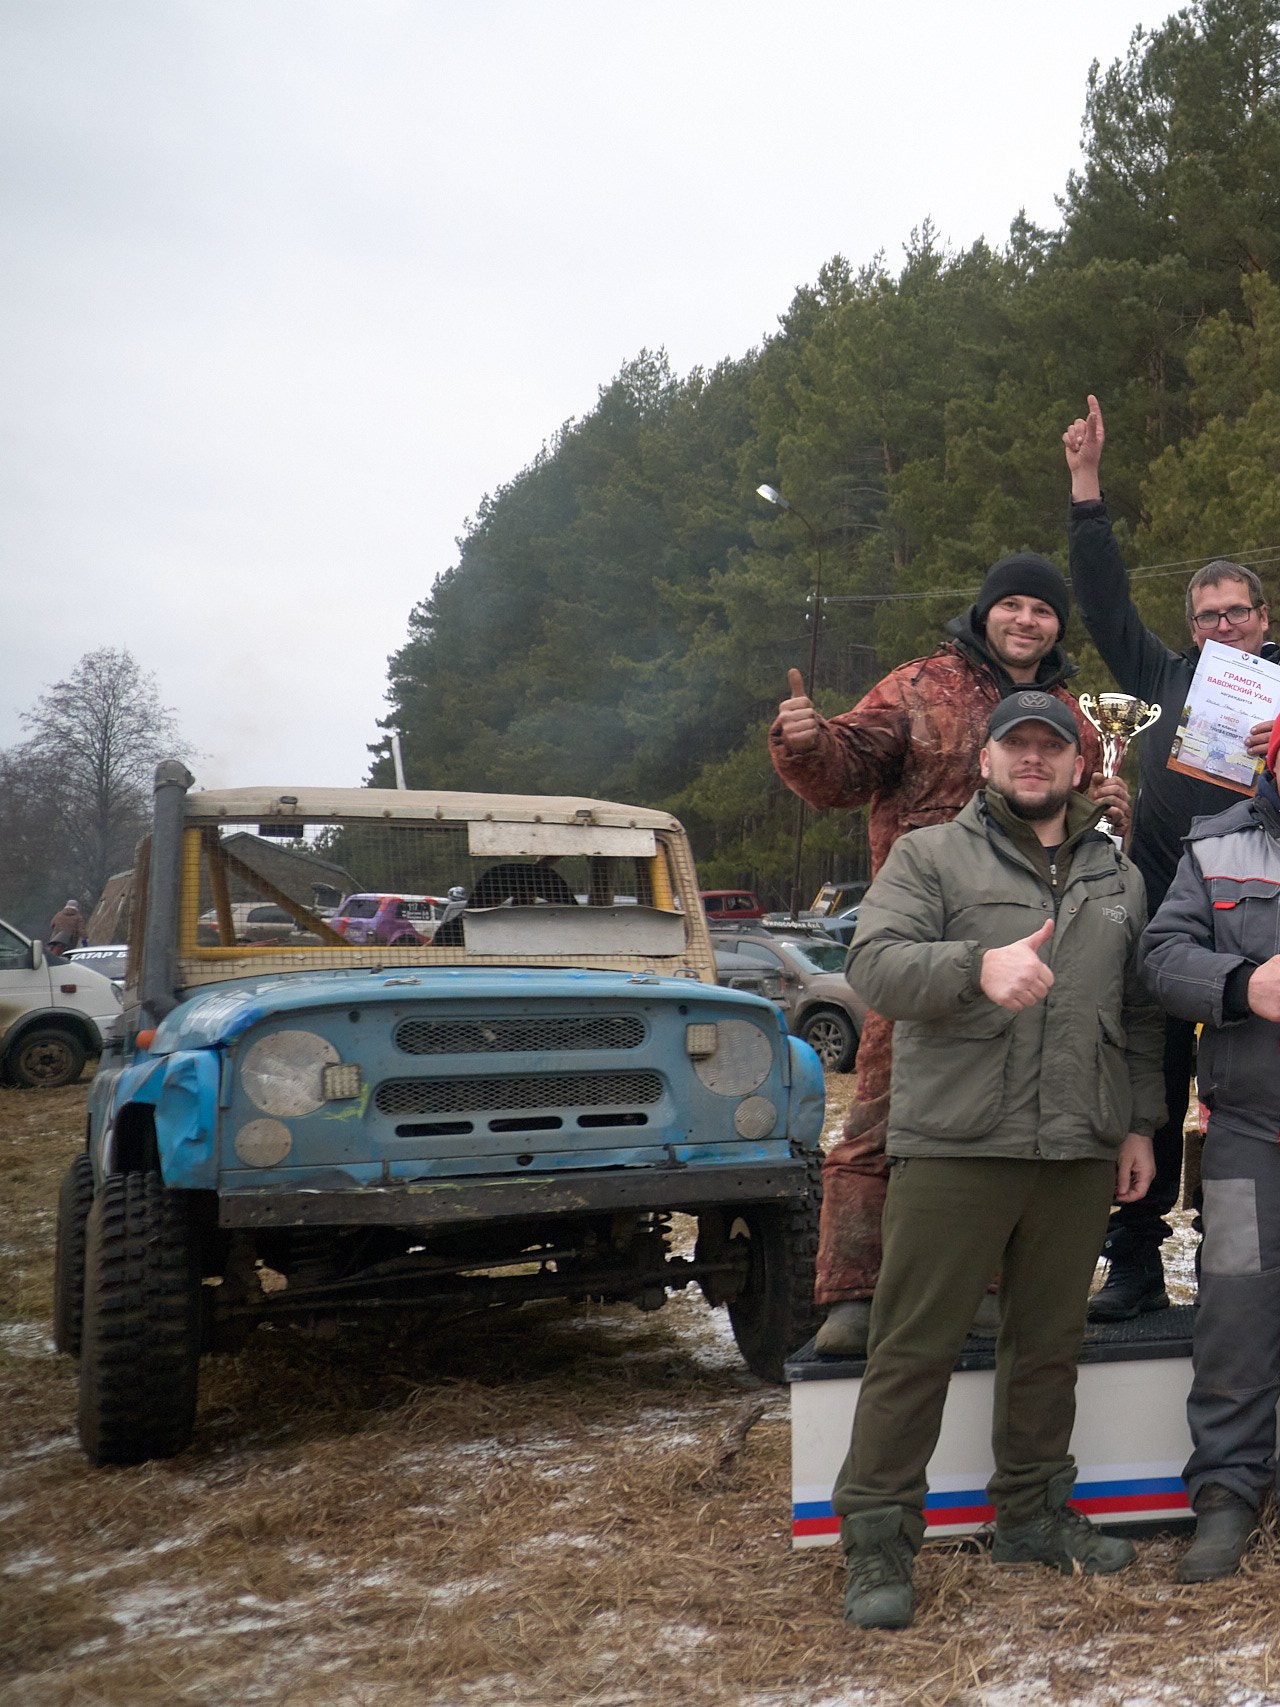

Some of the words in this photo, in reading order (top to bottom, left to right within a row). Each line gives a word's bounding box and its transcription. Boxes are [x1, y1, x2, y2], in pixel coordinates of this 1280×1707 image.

[1207, 675, 1253, 696] ВАВОЖСКИЙ
[1254, 691, 1273, 704] УХАБ
[1223, 671, 1262, 690] ГРАМОТА
[70, 951, 114, 961] ТАТАР
